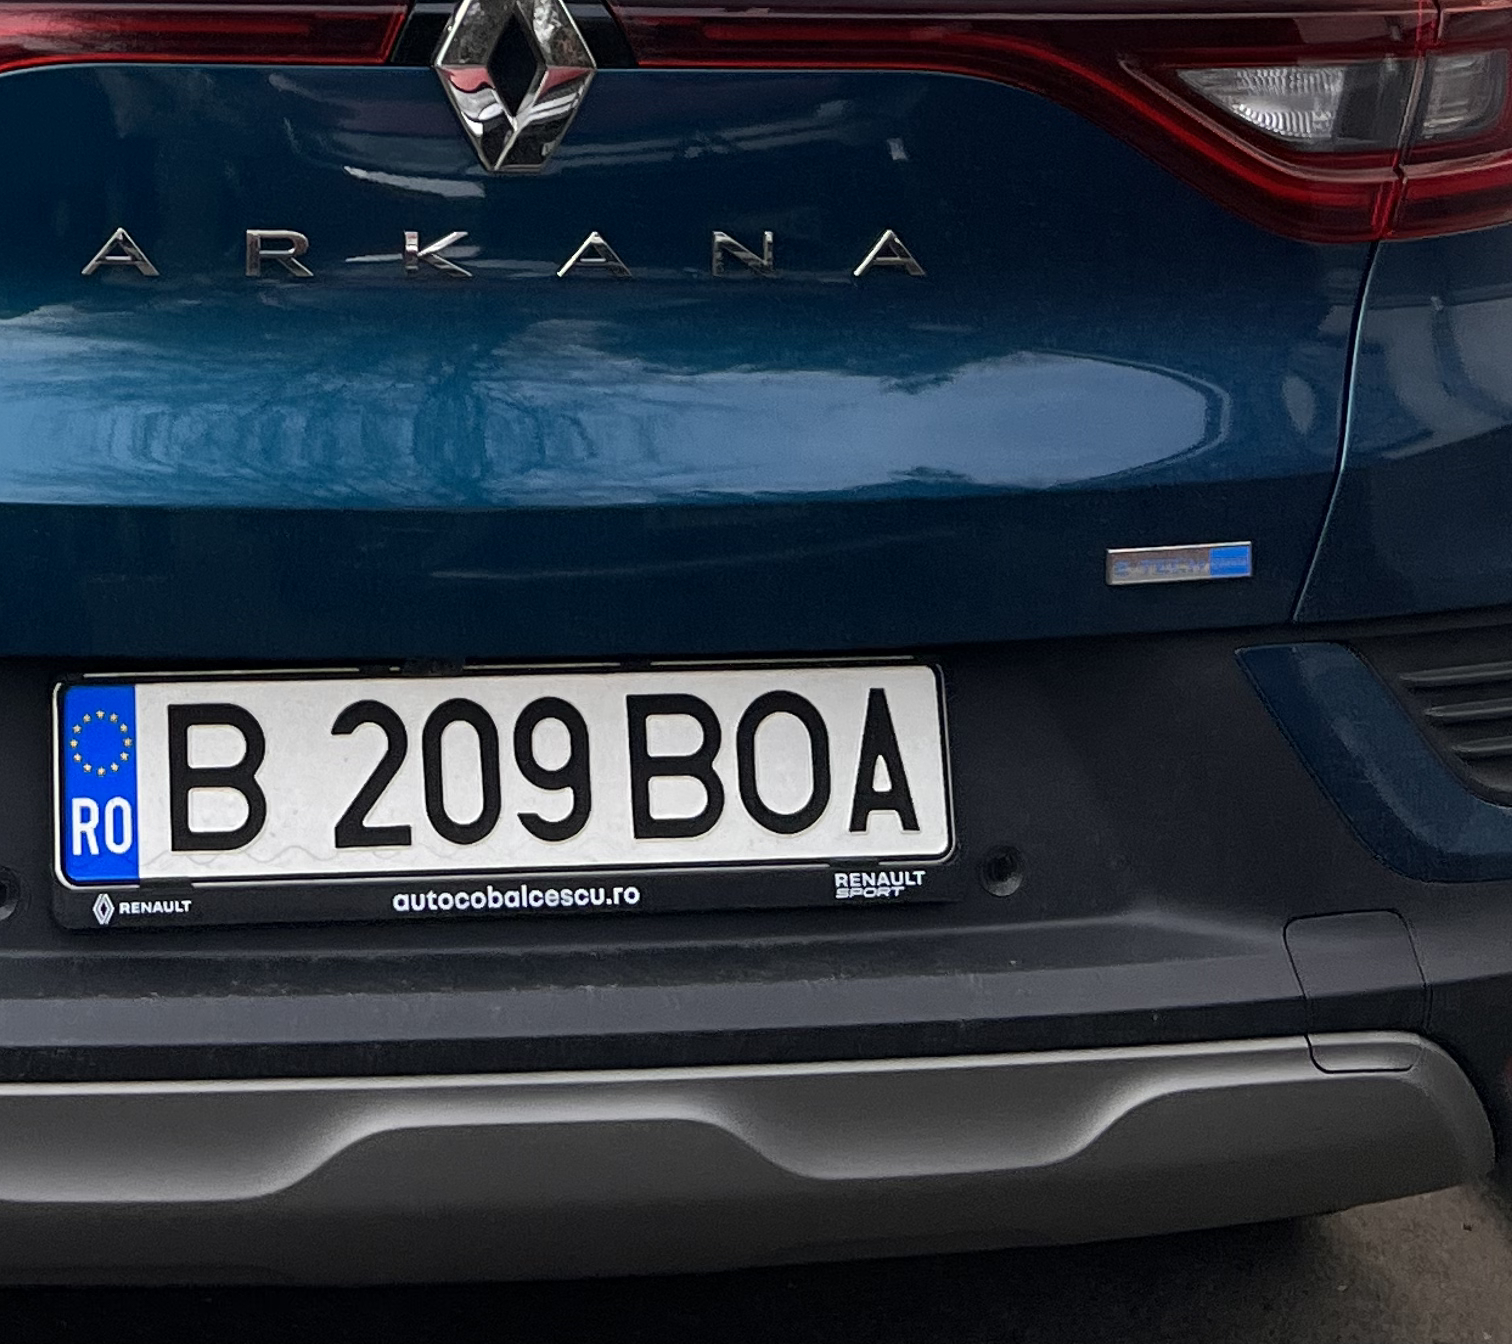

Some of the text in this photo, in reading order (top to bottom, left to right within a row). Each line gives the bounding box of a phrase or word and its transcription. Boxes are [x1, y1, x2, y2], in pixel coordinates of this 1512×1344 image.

[81, 227, 926, 278] ARKANA
[167, 687, 921, 852] B 209 BOA
[72, 796, 133, 856] RO
[834, 871, 926, 887] RENAULT
[835, 886, 905, 899] SPORT
[119, 900, 192, 914] RENAULT
[392, 885, 640, 912] autocobalcescu.ro
